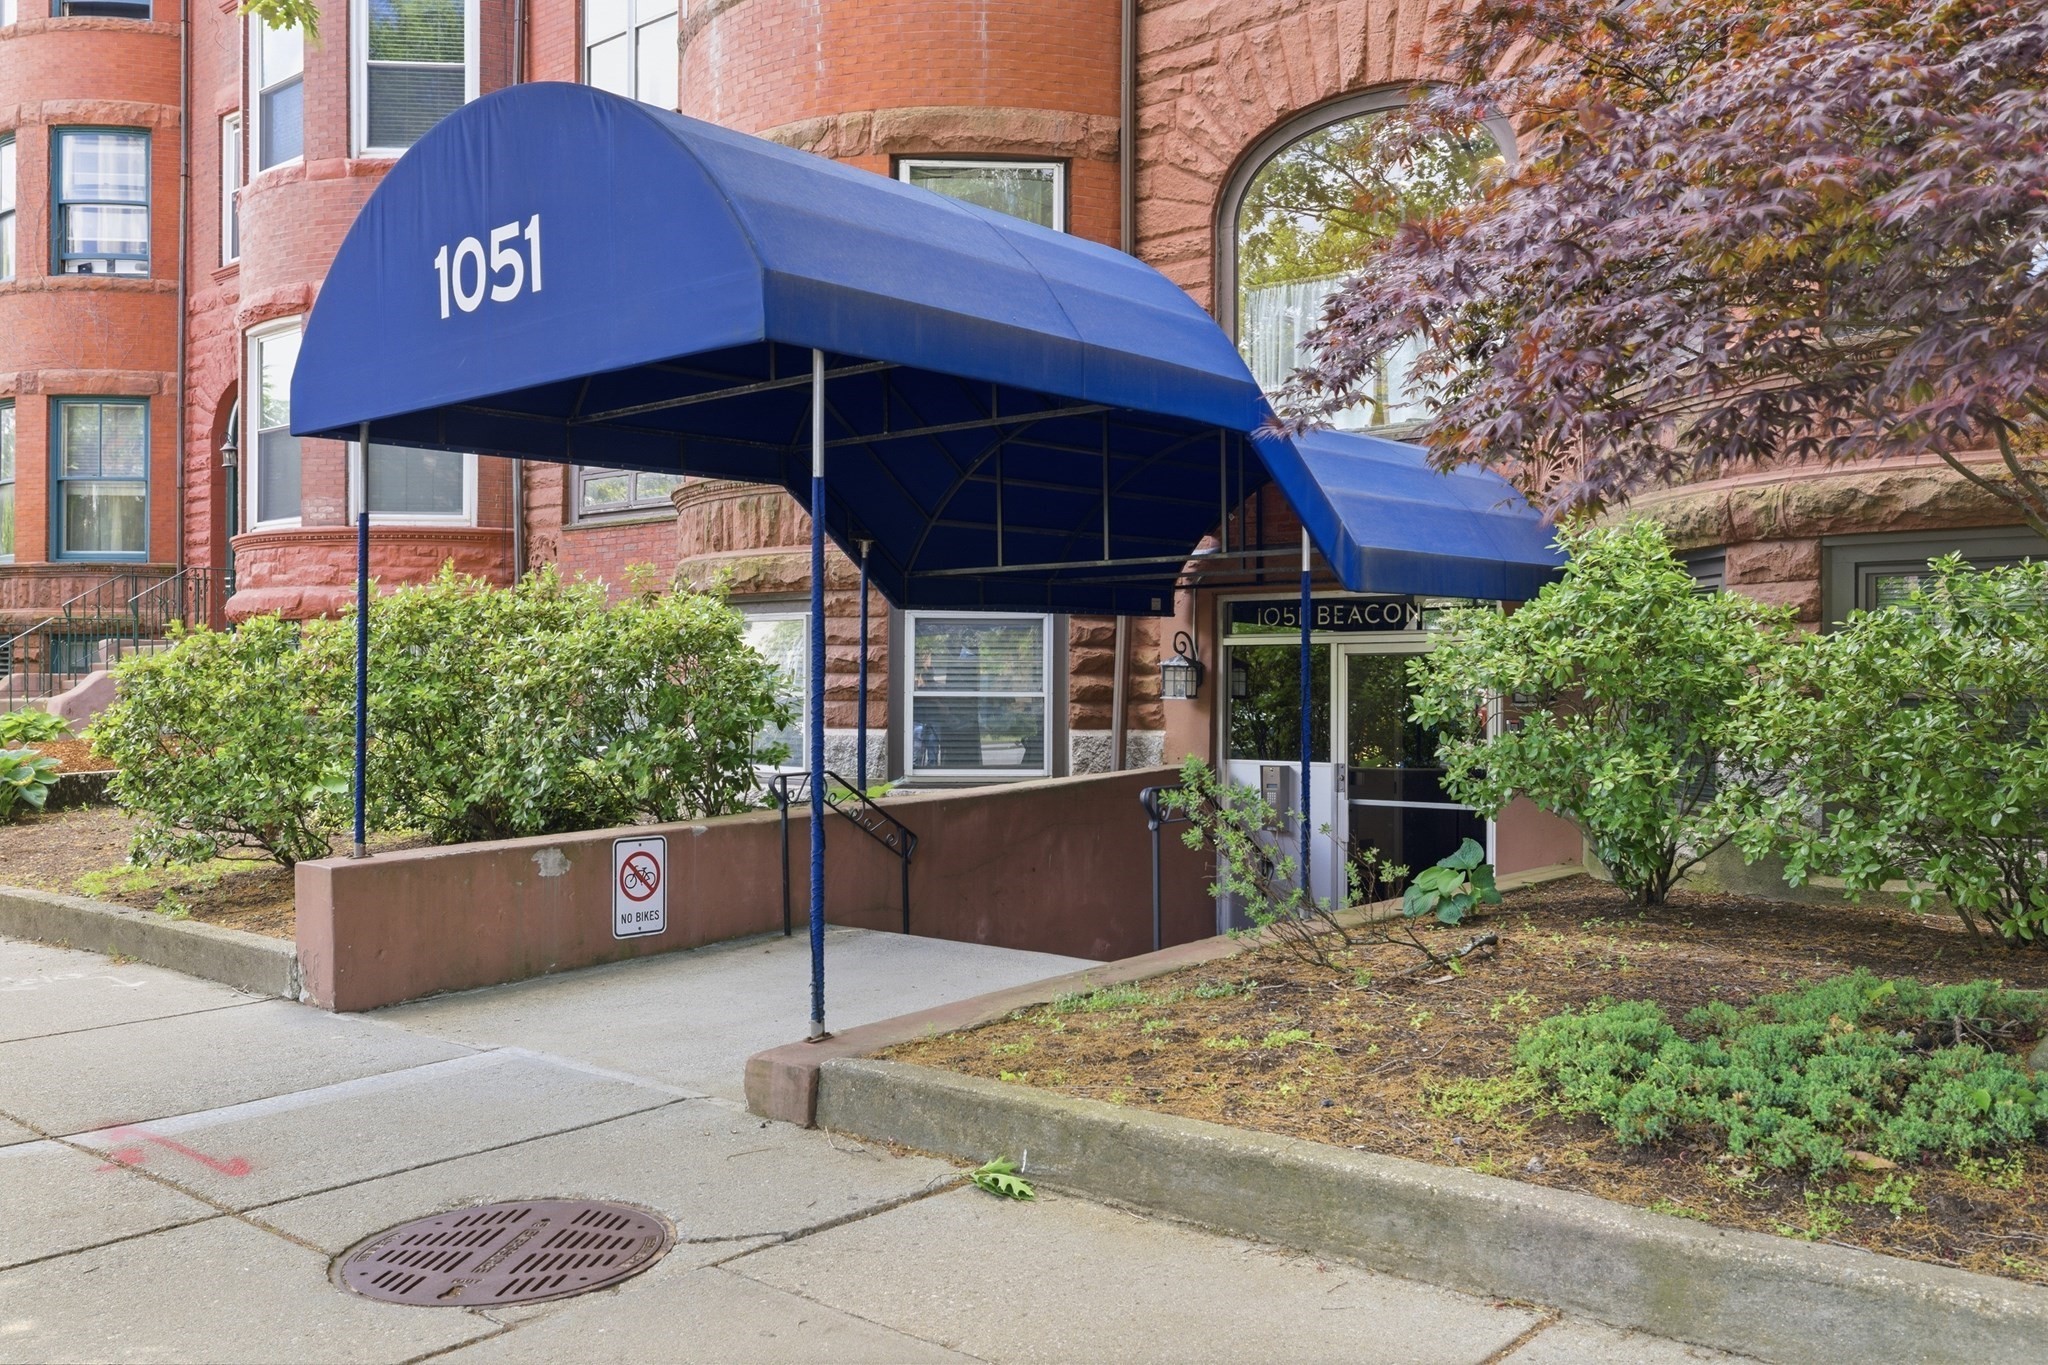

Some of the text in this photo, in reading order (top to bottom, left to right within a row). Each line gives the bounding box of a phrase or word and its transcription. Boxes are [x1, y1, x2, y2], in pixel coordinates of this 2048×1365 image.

[434, 213, 542, 320] 1051
[1317, 602, 1421, 625] BEACON
[621, 910, 660, 924] NO BIKES
